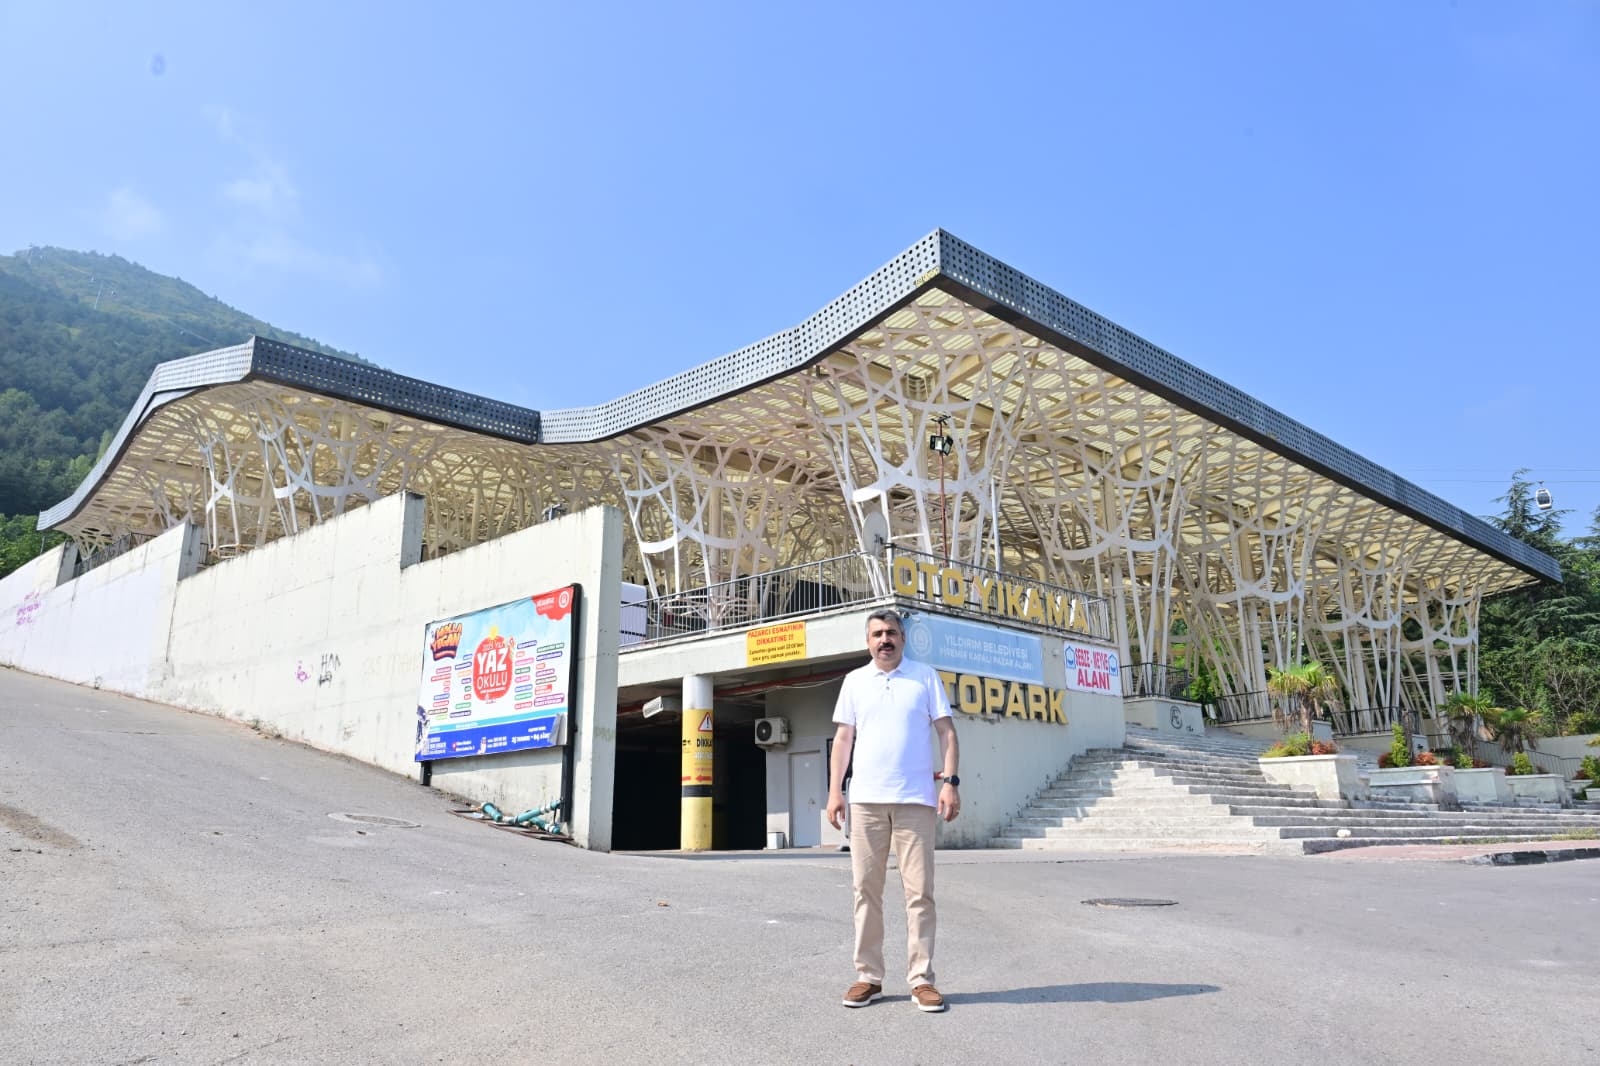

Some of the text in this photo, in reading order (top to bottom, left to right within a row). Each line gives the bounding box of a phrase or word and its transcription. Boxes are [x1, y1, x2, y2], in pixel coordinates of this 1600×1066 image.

[893, 556, 1090, 634] OTO YIKAMA
[477, 647, 509, 675] YAZ
[477, 672, 508, 690] OKULU
[1078, 668, 1110, 690] ALANI
[938, 670, 1069, 725] TOPARK
